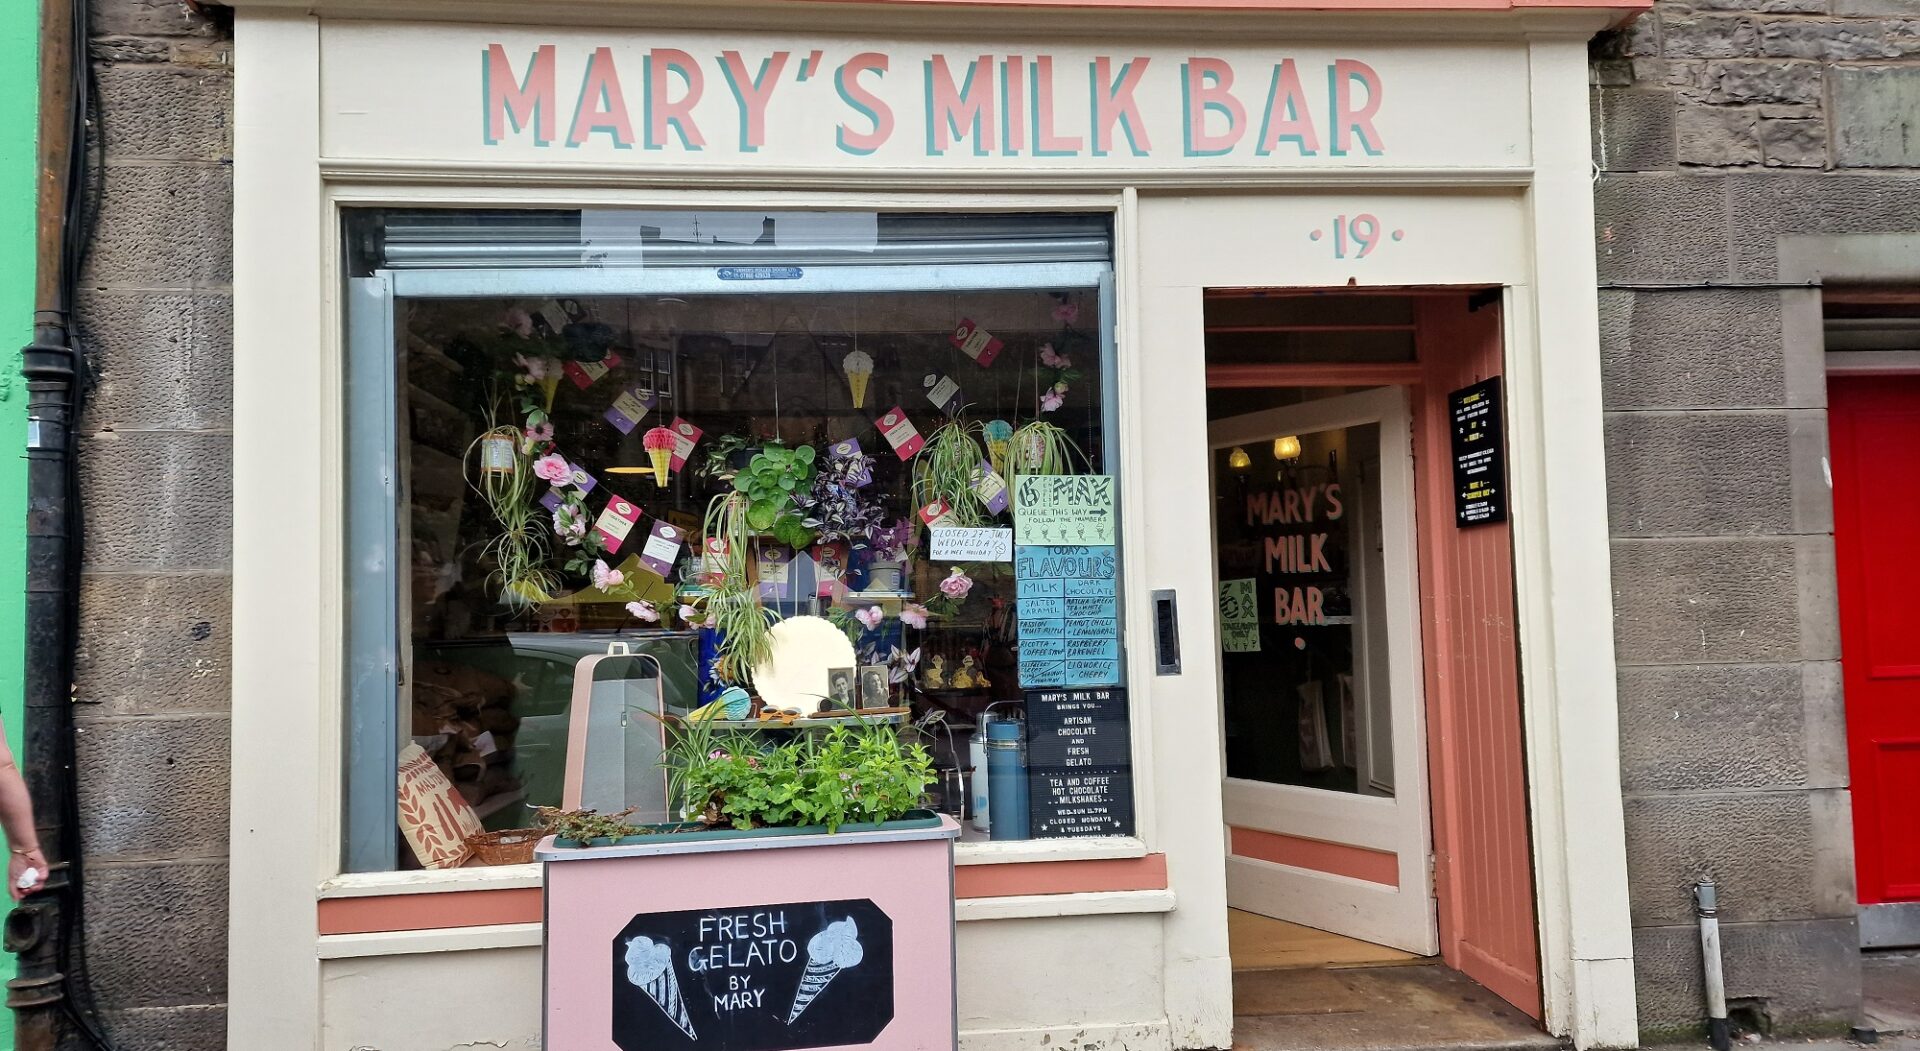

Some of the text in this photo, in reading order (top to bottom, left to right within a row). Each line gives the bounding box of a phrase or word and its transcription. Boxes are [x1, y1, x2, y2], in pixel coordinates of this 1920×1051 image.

[481, 43, 1385, 158] MARY'S MILK BAR
[1333, 213, 1381, 259] 19
[1018, 476, 1041, 507] 6
[1053, 476, 1112, 506] MAX
[1247, 484, 1343, 526] MARY'S
[1018, 508, 1048, 516] QUEUE
[1051, 508, 1068, 516] THIS
[932, 529, 968, 538] CLOSED
[989, 529, 1011, 539] JULY
[938, 540, 998, 548] WEDNESDAY
[1046, 546, 1089, 556] TODAYS
[1264, 533, 1332, 574] MILK
[1018, 556, 1115, 579] FLAVOURS
[1023, 583, 1058, 594] MILK
[1025, 600, 1056, 608] SALTED
[1220, 583, 1239, 619] 6
[1240, 581, 1255, 618] MAX
[1275, 586, 1328, 626] BAR
[1020, 640, 1049, 648] RICOTTA
[1067, 660, 1113, 670] LIQUORICE
[1041, 691, 1110, 702] MARY'S MILK BAR
[1063, 716, 1092, 725] ARTISAN
[1057, 727, 1097, 736] CHOCOLATE
[1067, 747, 1090, 755] FRESH
[1065, 758, 1092, 767] GELATO
[1049, 776, 1110, 788] TEA AND COFFEE
[1052, 785, 1109, 796] HOT CHOCOLATE
[699, 911, 785, 942] FRESH
[688, 939, 798, 972] GELATO
[729, 975, 751, 991] BY
[714, 988, 766, 1012] MARY
